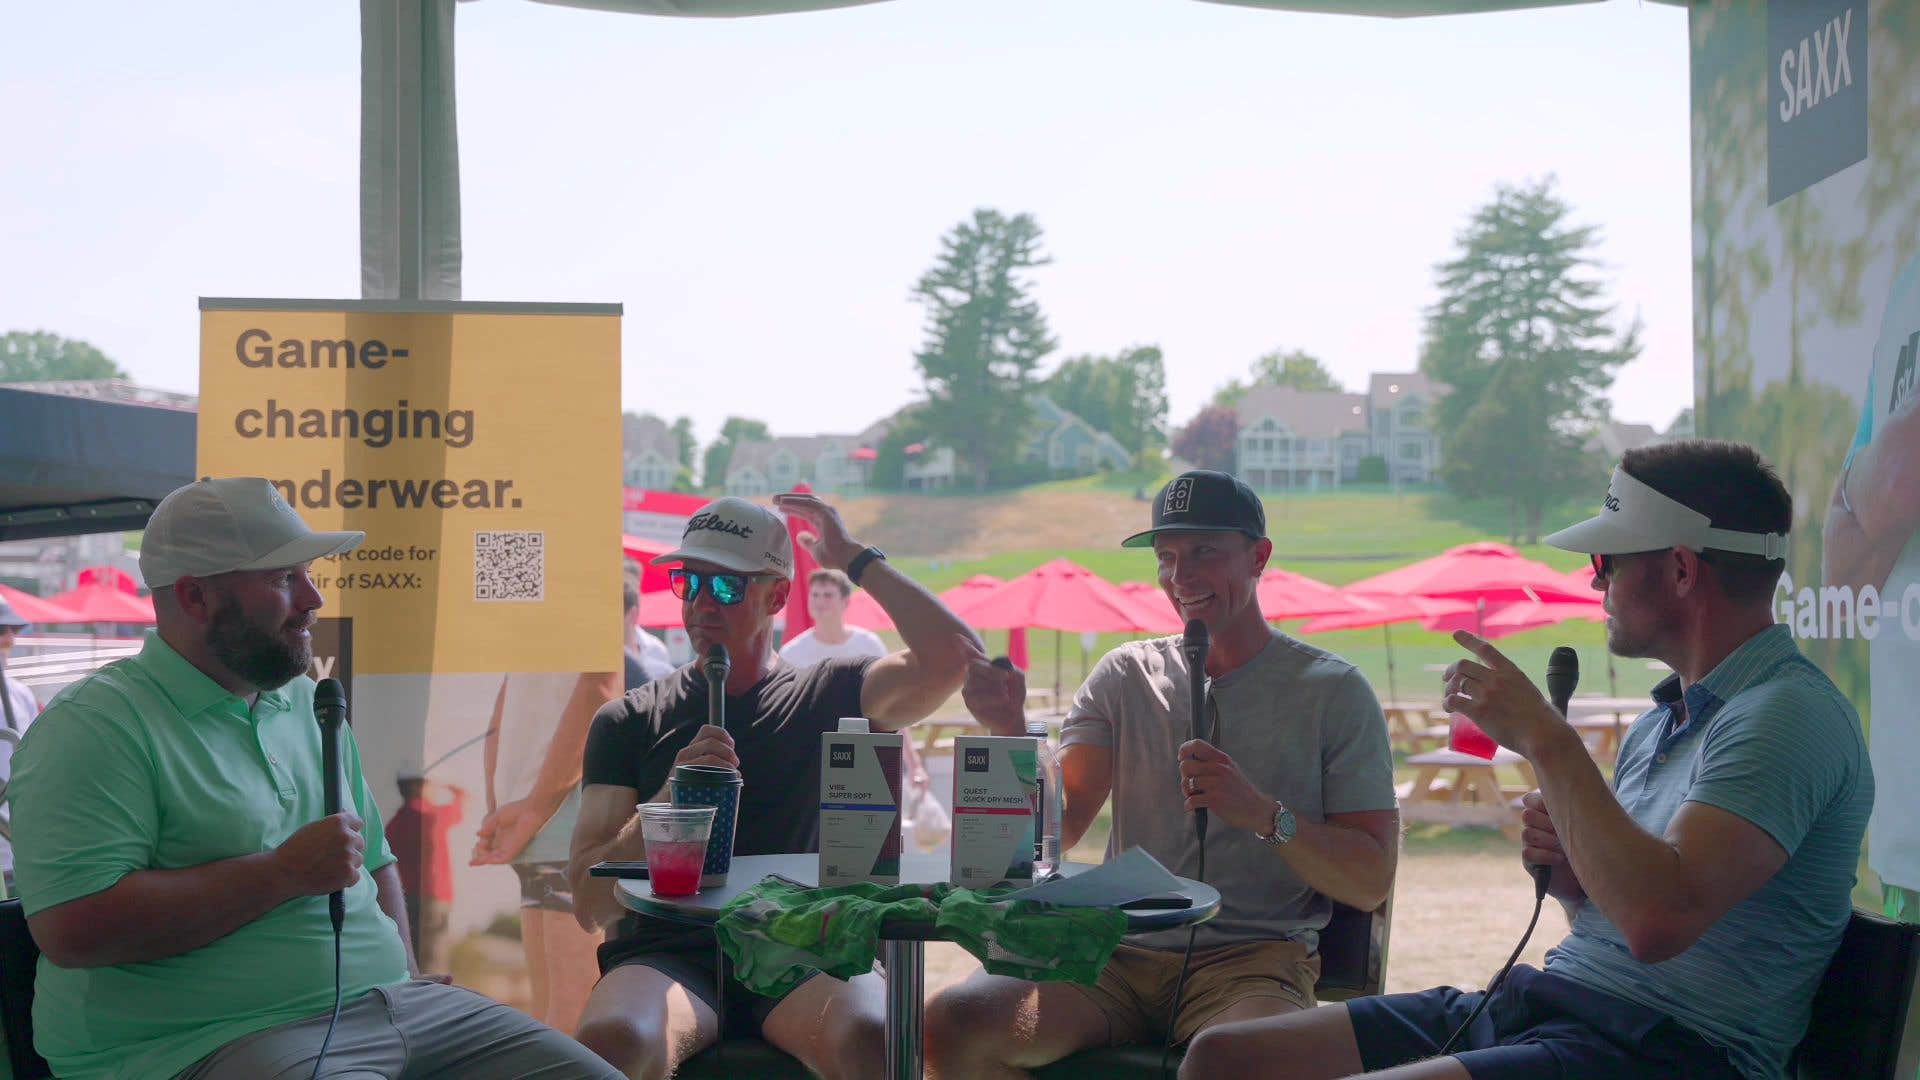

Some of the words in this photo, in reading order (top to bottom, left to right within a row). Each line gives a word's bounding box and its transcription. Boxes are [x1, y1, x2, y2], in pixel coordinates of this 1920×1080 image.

[1780, 7, 1852, 122] SAXX
[235, 328, 409, 369] Game-
[234, 400, 475, 448] changing
[272, 469, 522, 509] nderwear.
[682, 512, 754, 539] Titleist
[356, 545, 404, 561] code
[409, 545, 437, 561] for
[335, 573, 355, 589] of
[359, 573, 422, 589] SAXX:
[832, 751, 852, 761] SAXX
[967, 755, 986, 765] SAXX
[828, 792, 852, 800] SUPER
[853, 792, 873, 800] SOFT
[963, 788, 988, 796] QUEST
[963, 796, 986, 804] QUICK
[1003, 797, 1024, 805] MESH
